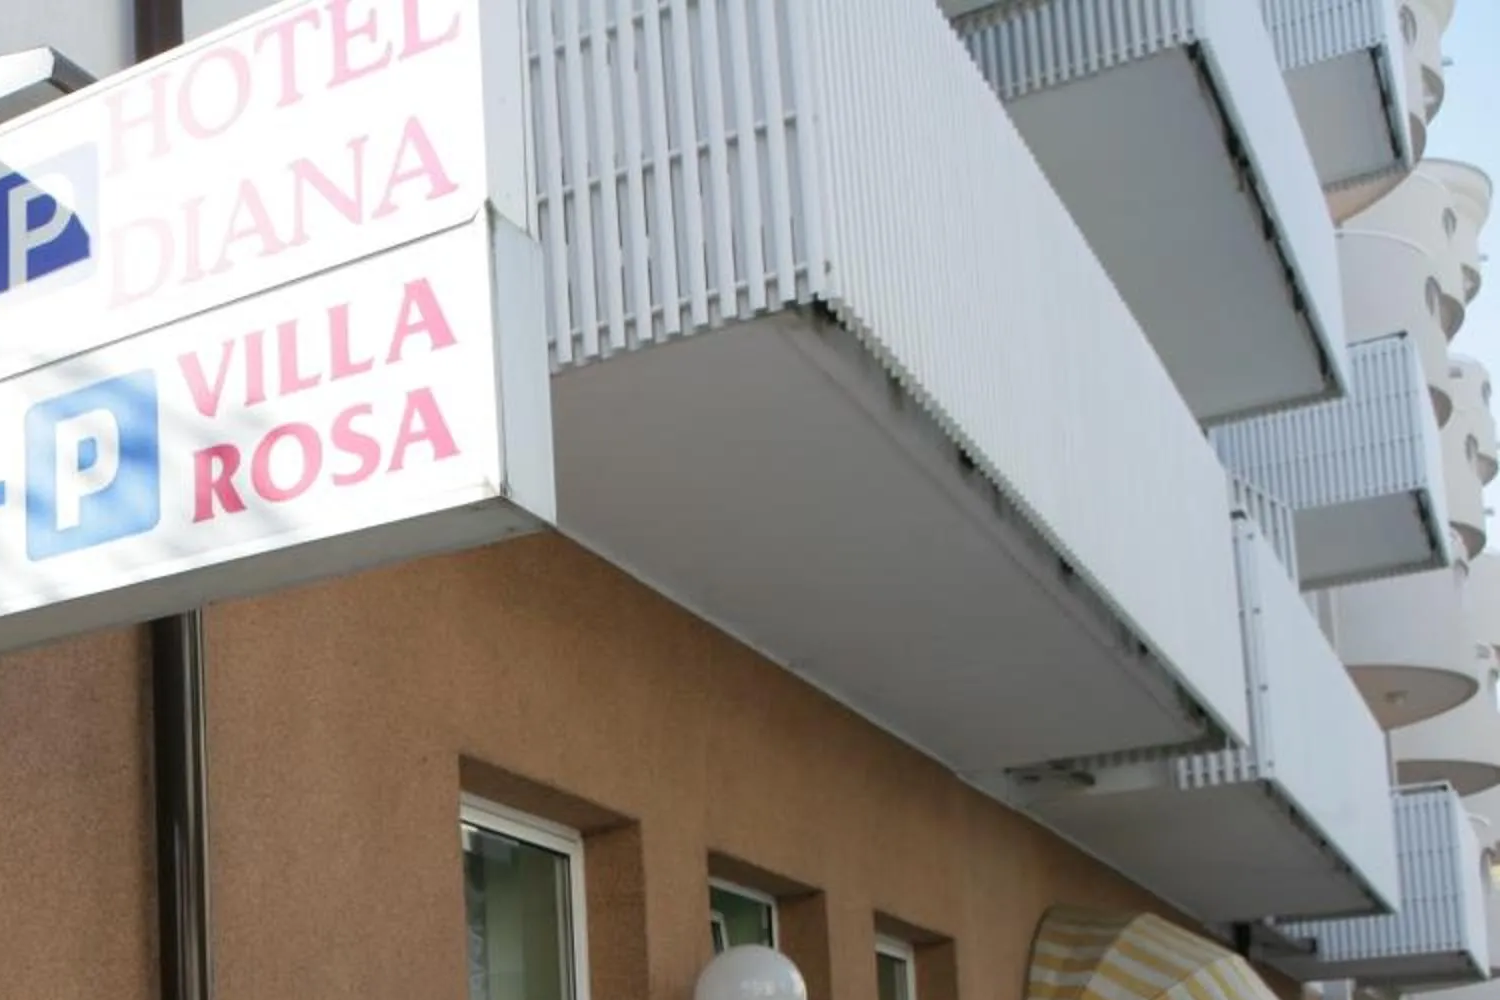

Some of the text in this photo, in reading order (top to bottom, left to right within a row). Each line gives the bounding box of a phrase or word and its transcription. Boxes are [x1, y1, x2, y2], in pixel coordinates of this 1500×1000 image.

[105, 0, 463, 178] HOTEL
[8, 170, 77, 290] P
[105, 115, 460, 311] DIANA
[177, 277, 458, 418] VILLA
[55, 408, 119, 533] P
[192, 386, 462, 523] ROSA
